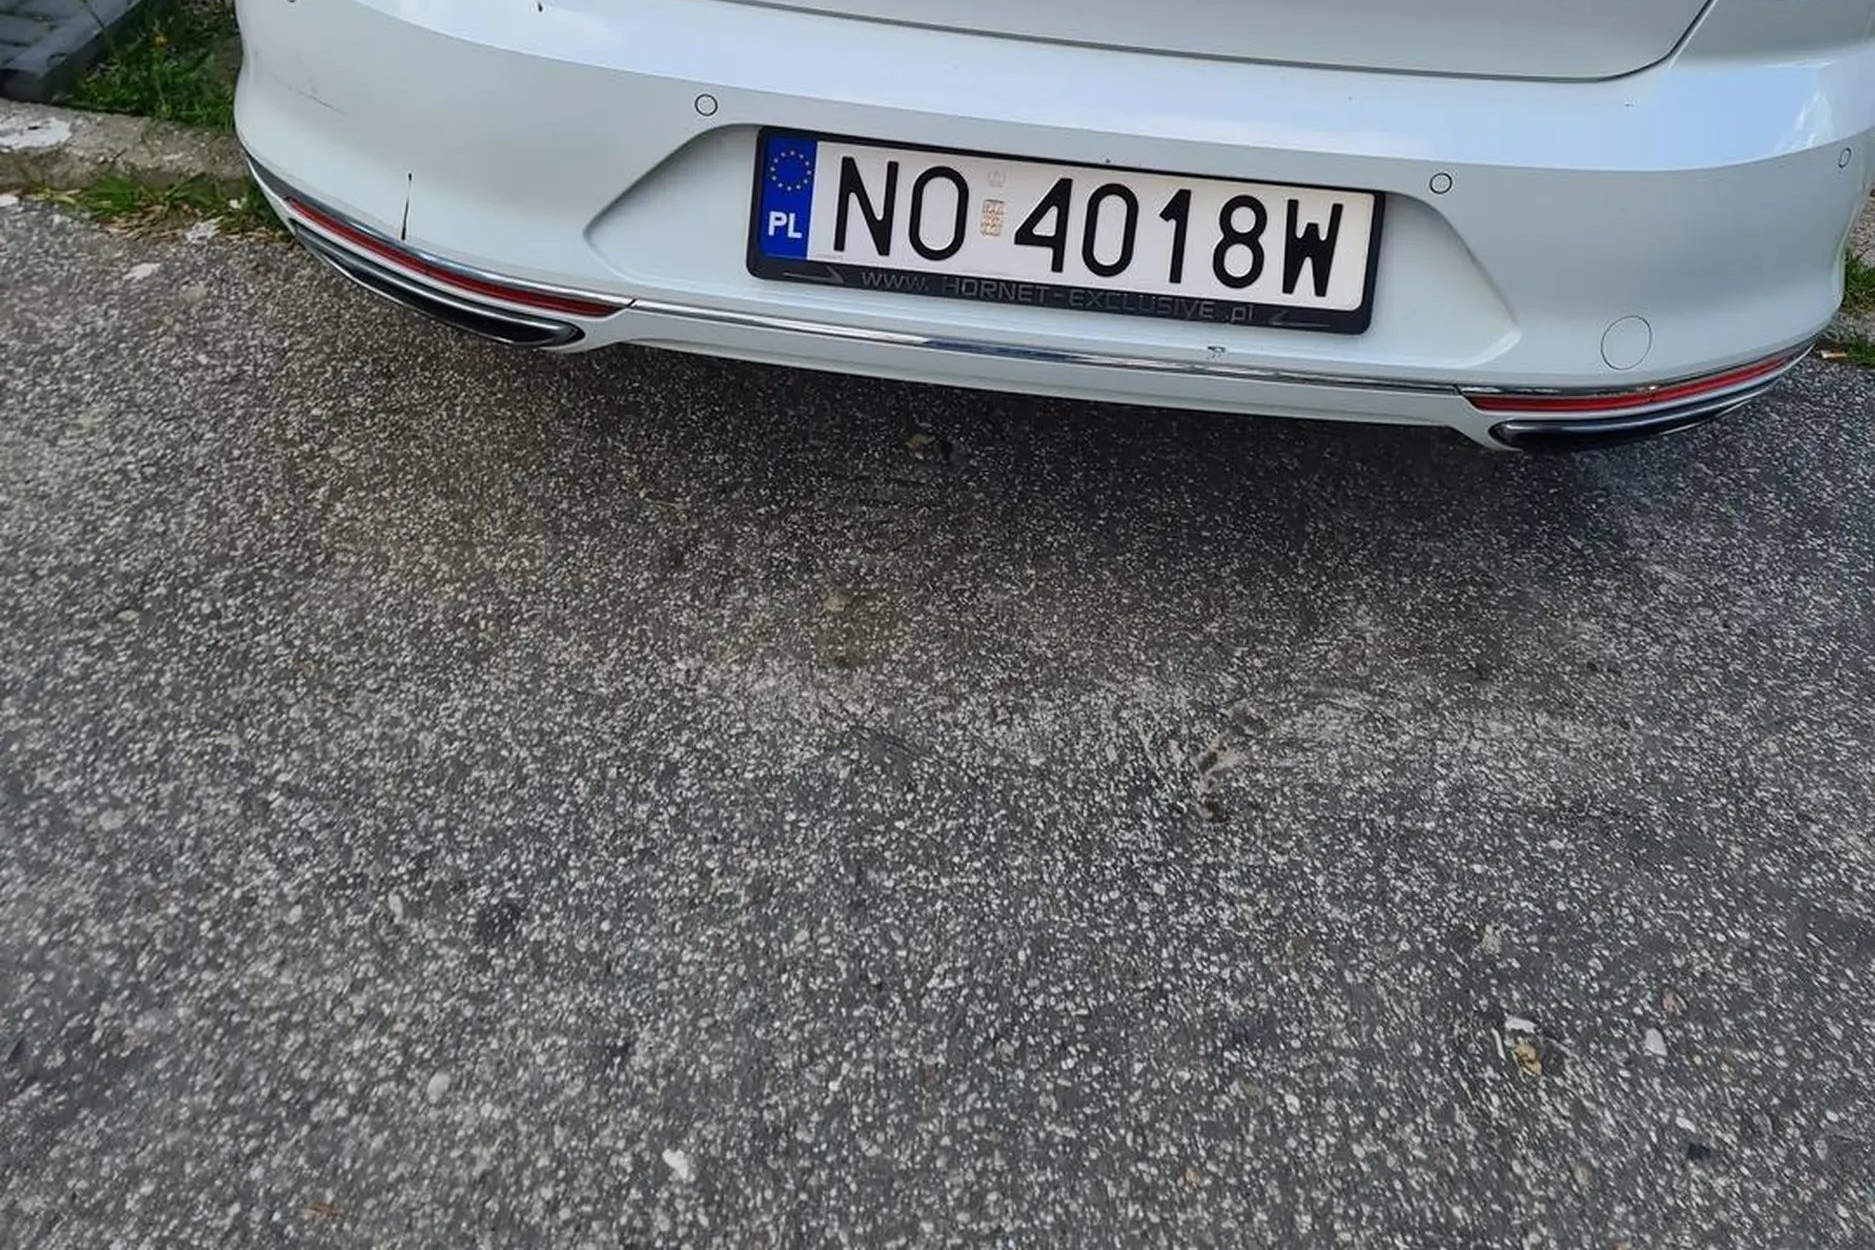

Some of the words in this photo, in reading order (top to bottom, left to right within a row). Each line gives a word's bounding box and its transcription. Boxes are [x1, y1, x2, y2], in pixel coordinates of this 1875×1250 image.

[766, 211, 803, 239] PL
[833, 156, 970, 261] NO
[1013, 177, 1344, 298] 4018W
